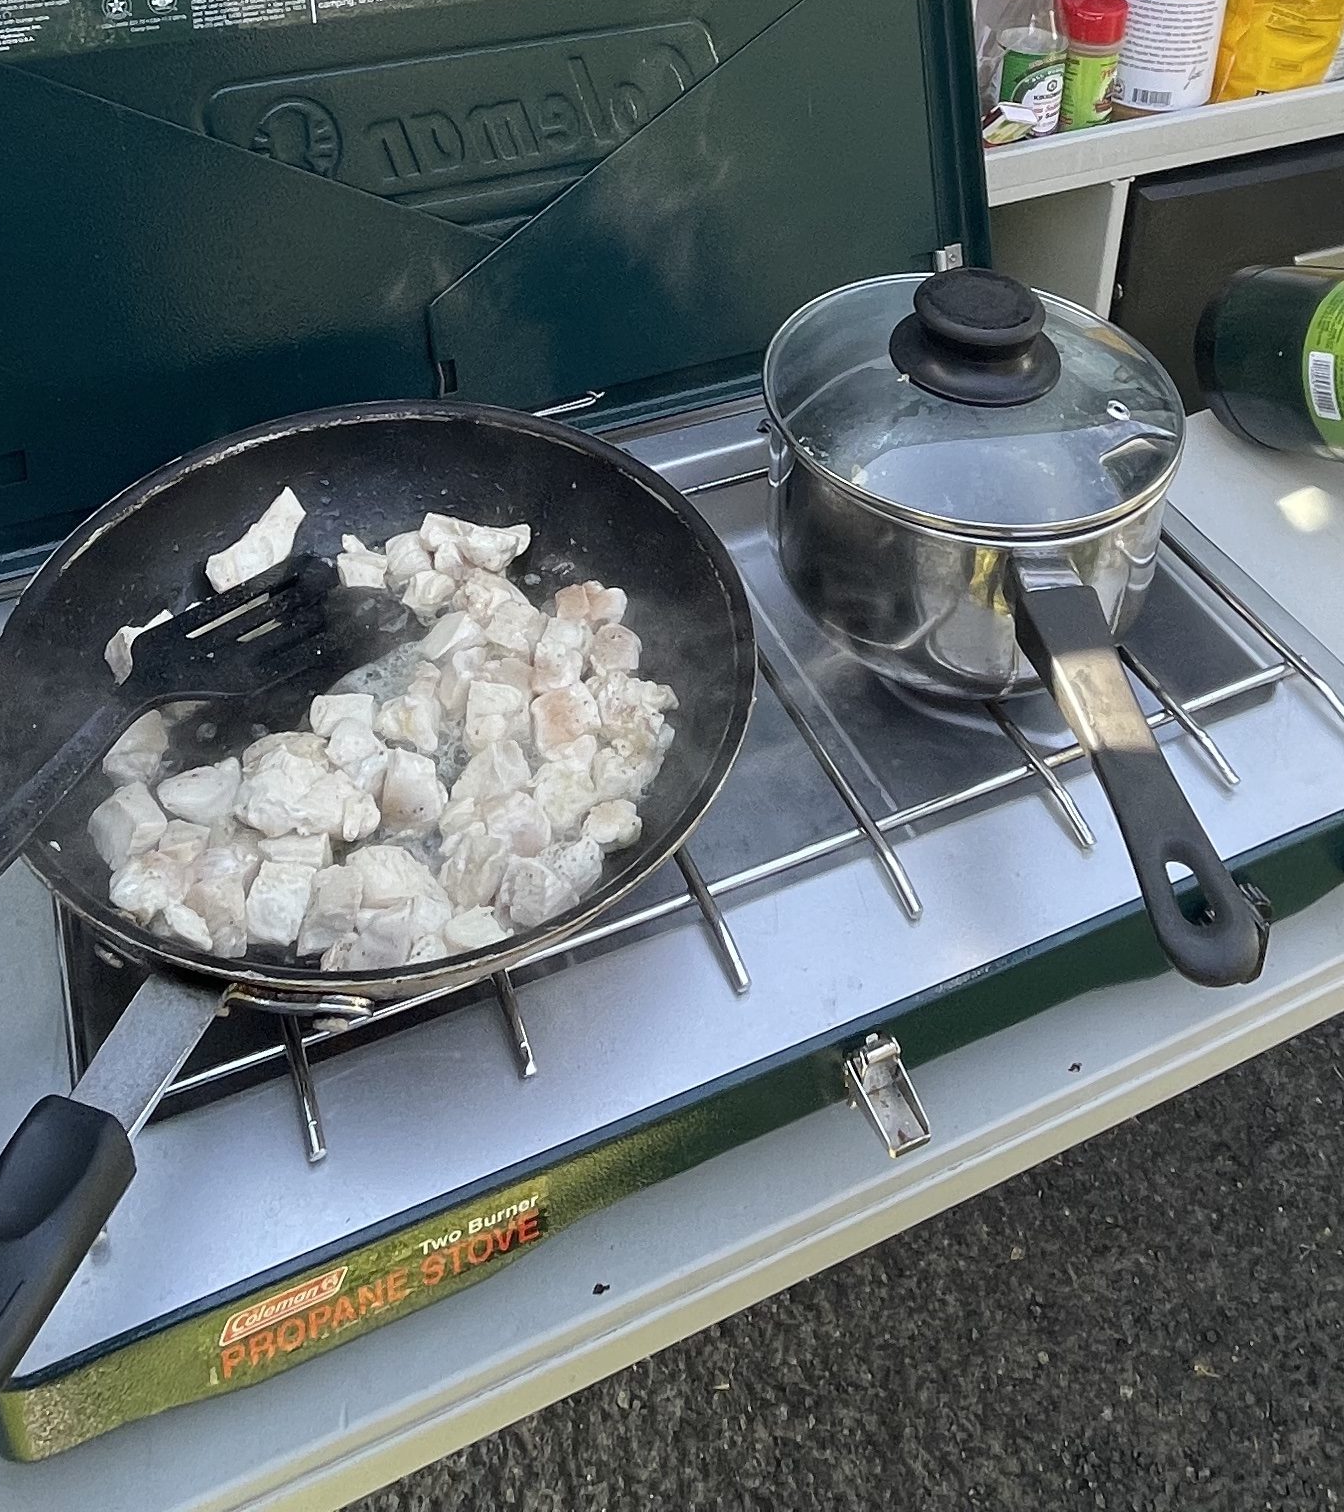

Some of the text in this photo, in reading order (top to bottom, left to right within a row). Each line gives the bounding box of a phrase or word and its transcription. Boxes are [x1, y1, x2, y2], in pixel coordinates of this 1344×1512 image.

[419, 1194, 539, 1255] Two Burner
[221, 1209, 541, 1379] PROPANE STOVE
[232, 1287, 319, 1333] Coleman
